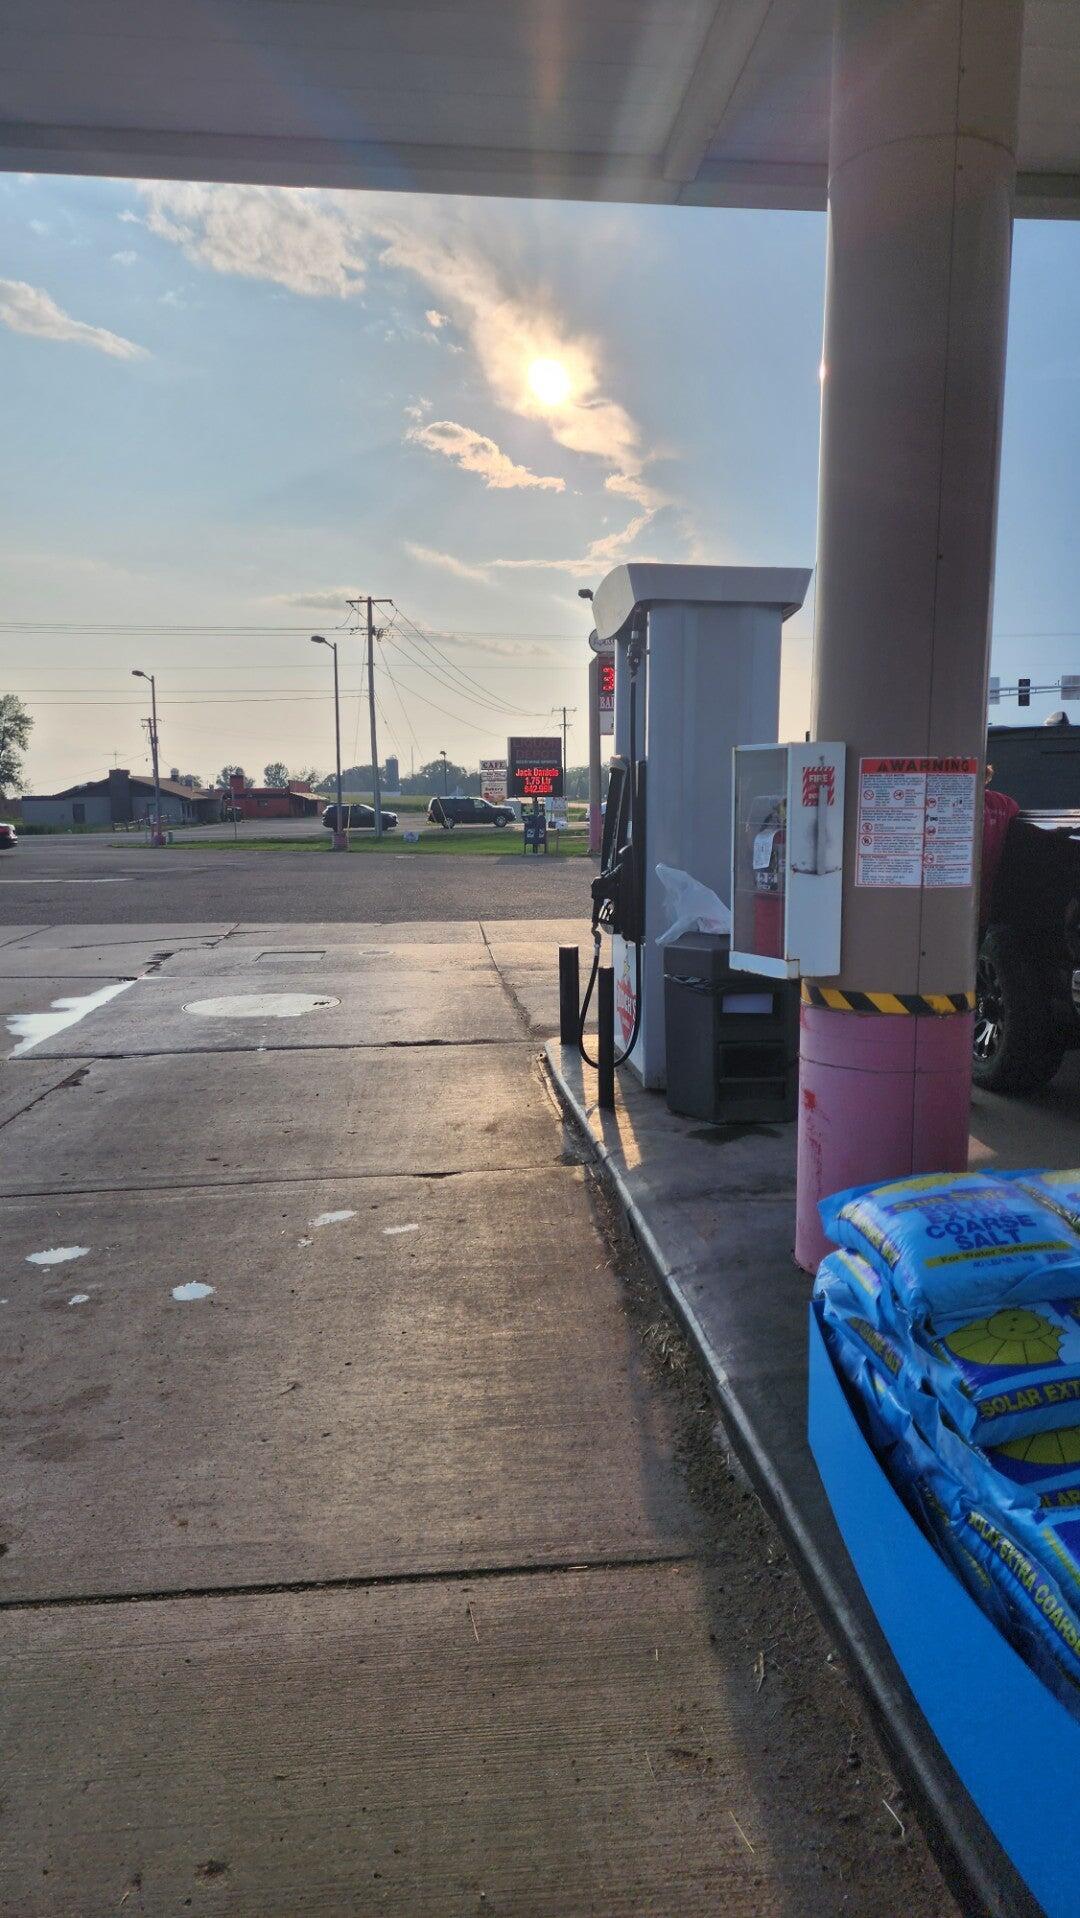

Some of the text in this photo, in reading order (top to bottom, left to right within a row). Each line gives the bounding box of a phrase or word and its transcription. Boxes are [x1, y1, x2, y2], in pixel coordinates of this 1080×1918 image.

[515, 768, 532, 777] Jack
[889, 759, 969, 772] WARNING
[525, 777, 540, 785] 1.75
[809, 774, 828, 782] FIRE
[926, 1213, 1037, 1239] COARSE
[954, 1224, 1022, 1250] SALT
[979, 1387, 1043, 1419] SOLAR
[1000, 1537, 1038, 1592] EXTRA
